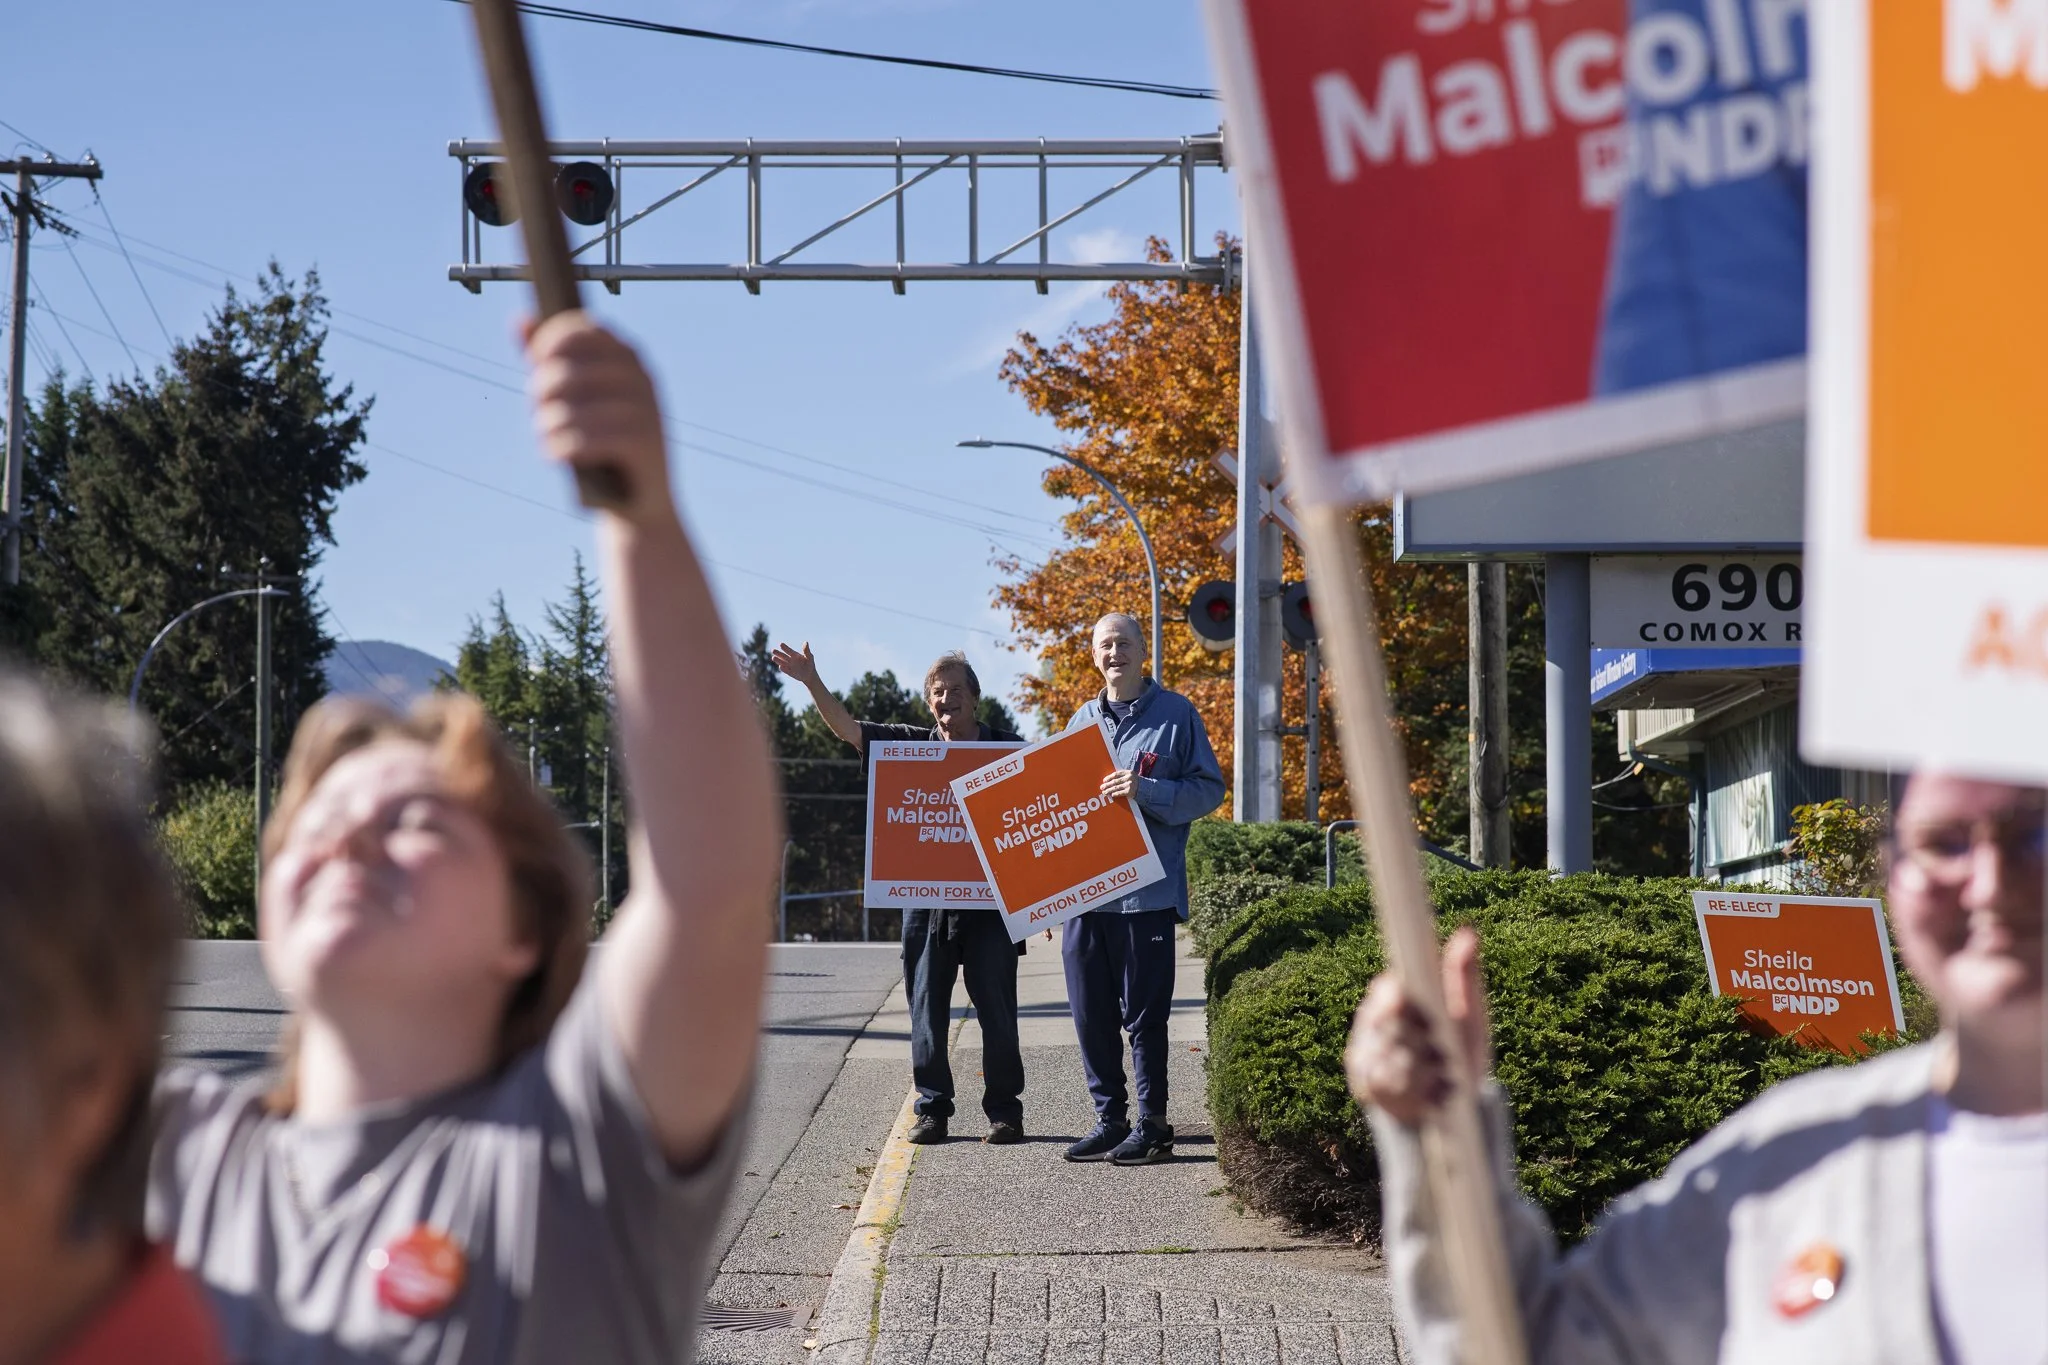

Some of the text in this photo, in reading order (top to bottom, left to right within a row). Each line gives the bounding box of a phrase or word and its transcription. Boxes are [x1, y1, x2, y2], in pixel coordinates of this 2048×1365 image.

[1671, 562, 1804, 612] 690
[1639, 622, 1768, 642] COMOX
[883, 747, 942, 757] RE-ELECT
[965, 759, 1019, 792] RE-ELECT
[993, 793, 1115, 854] Malcolmson
[1002, 792, 1060, 829] Sheila
[1045, 820, 1088, 853] NDP
[888, 886, 940, 898] ACTION
[944, 887, 972, 898] FOR
[1029, 866, 1137, 923] ACTION FOR YOU
[1708, 899, 1773, 913] RE-ELECT
[1743, 949, 1813, 971] Sheila
[1730, 969, 1875, 996] Malcolmson
[1789, 995, 1840, 1016] NDP
